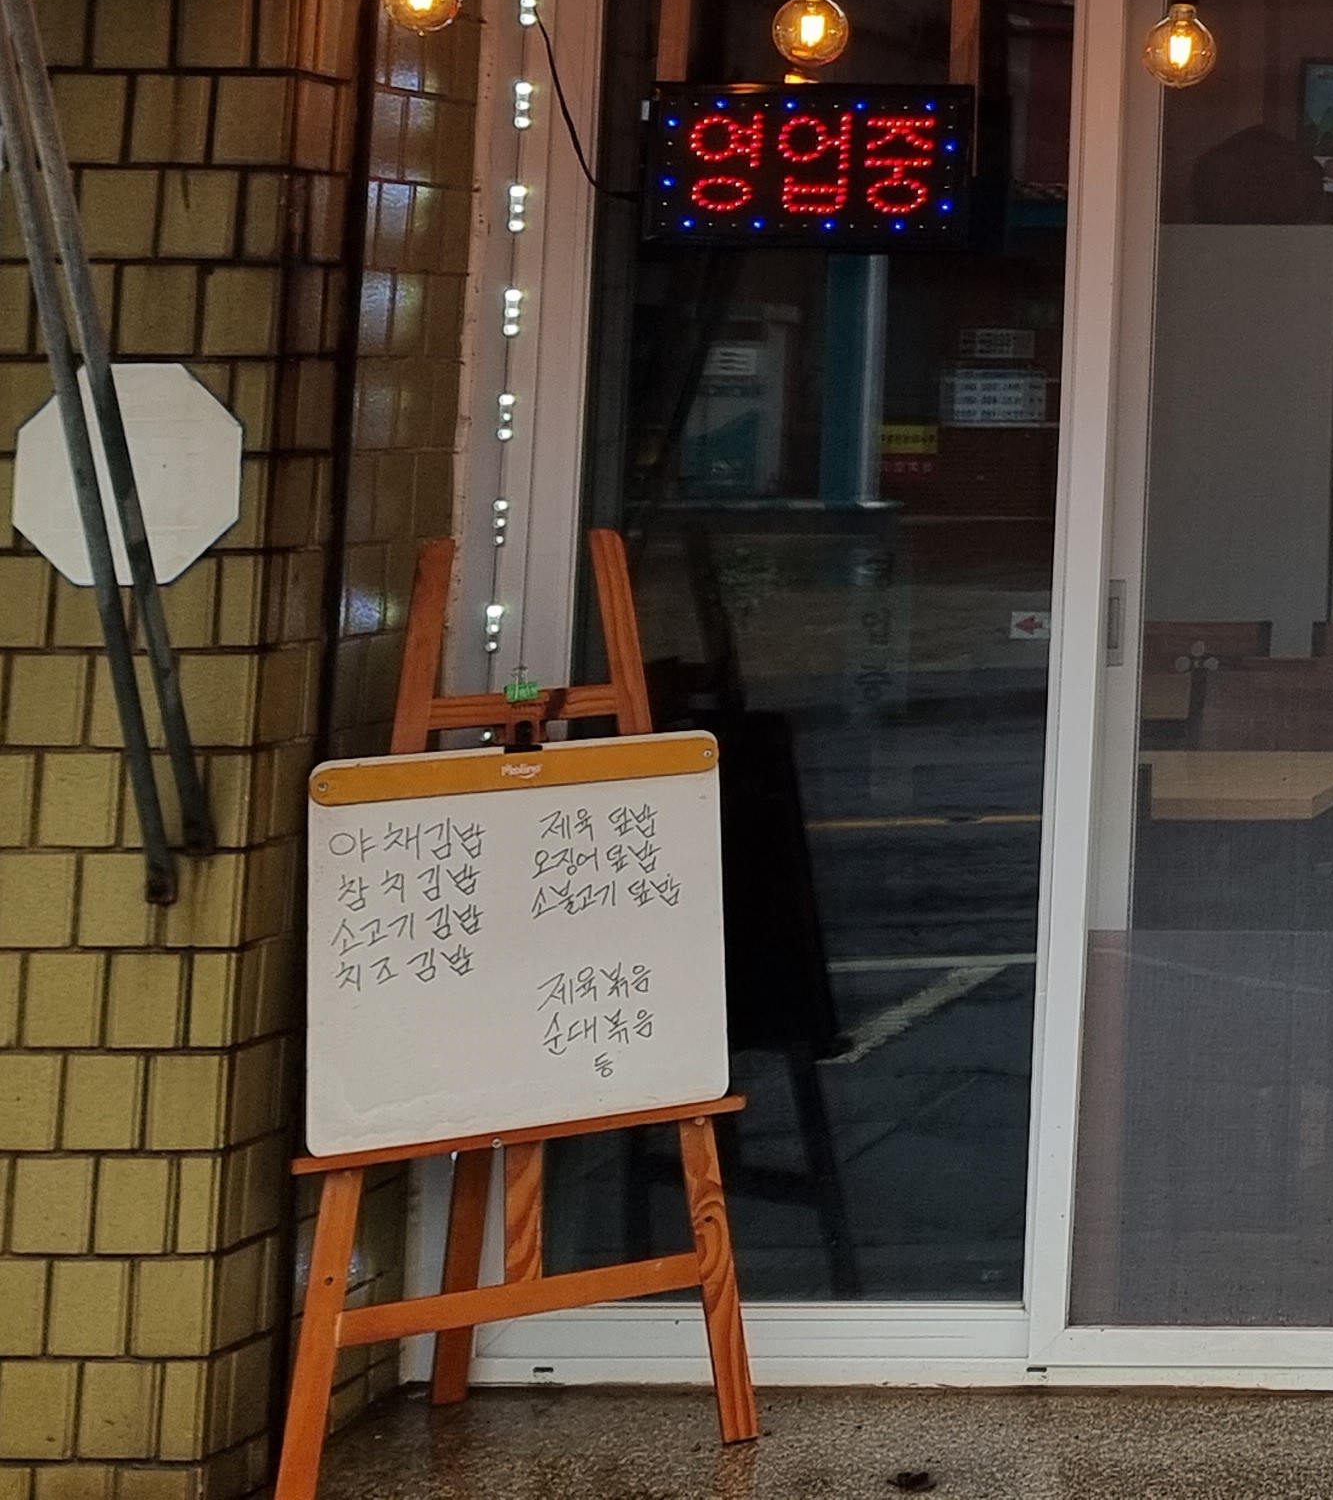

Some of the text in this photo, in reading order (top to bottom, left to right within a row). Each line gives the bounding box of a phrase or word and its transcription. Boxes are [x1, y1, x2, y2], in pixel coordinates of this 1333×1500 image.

[688, 112, 936, 214] 영업중
[538, 803, 658, 841] 제육 덮밥
[531, 839, 661, 879] 오징어 덮밥
[531, 879, 616, 919] 소불고기
